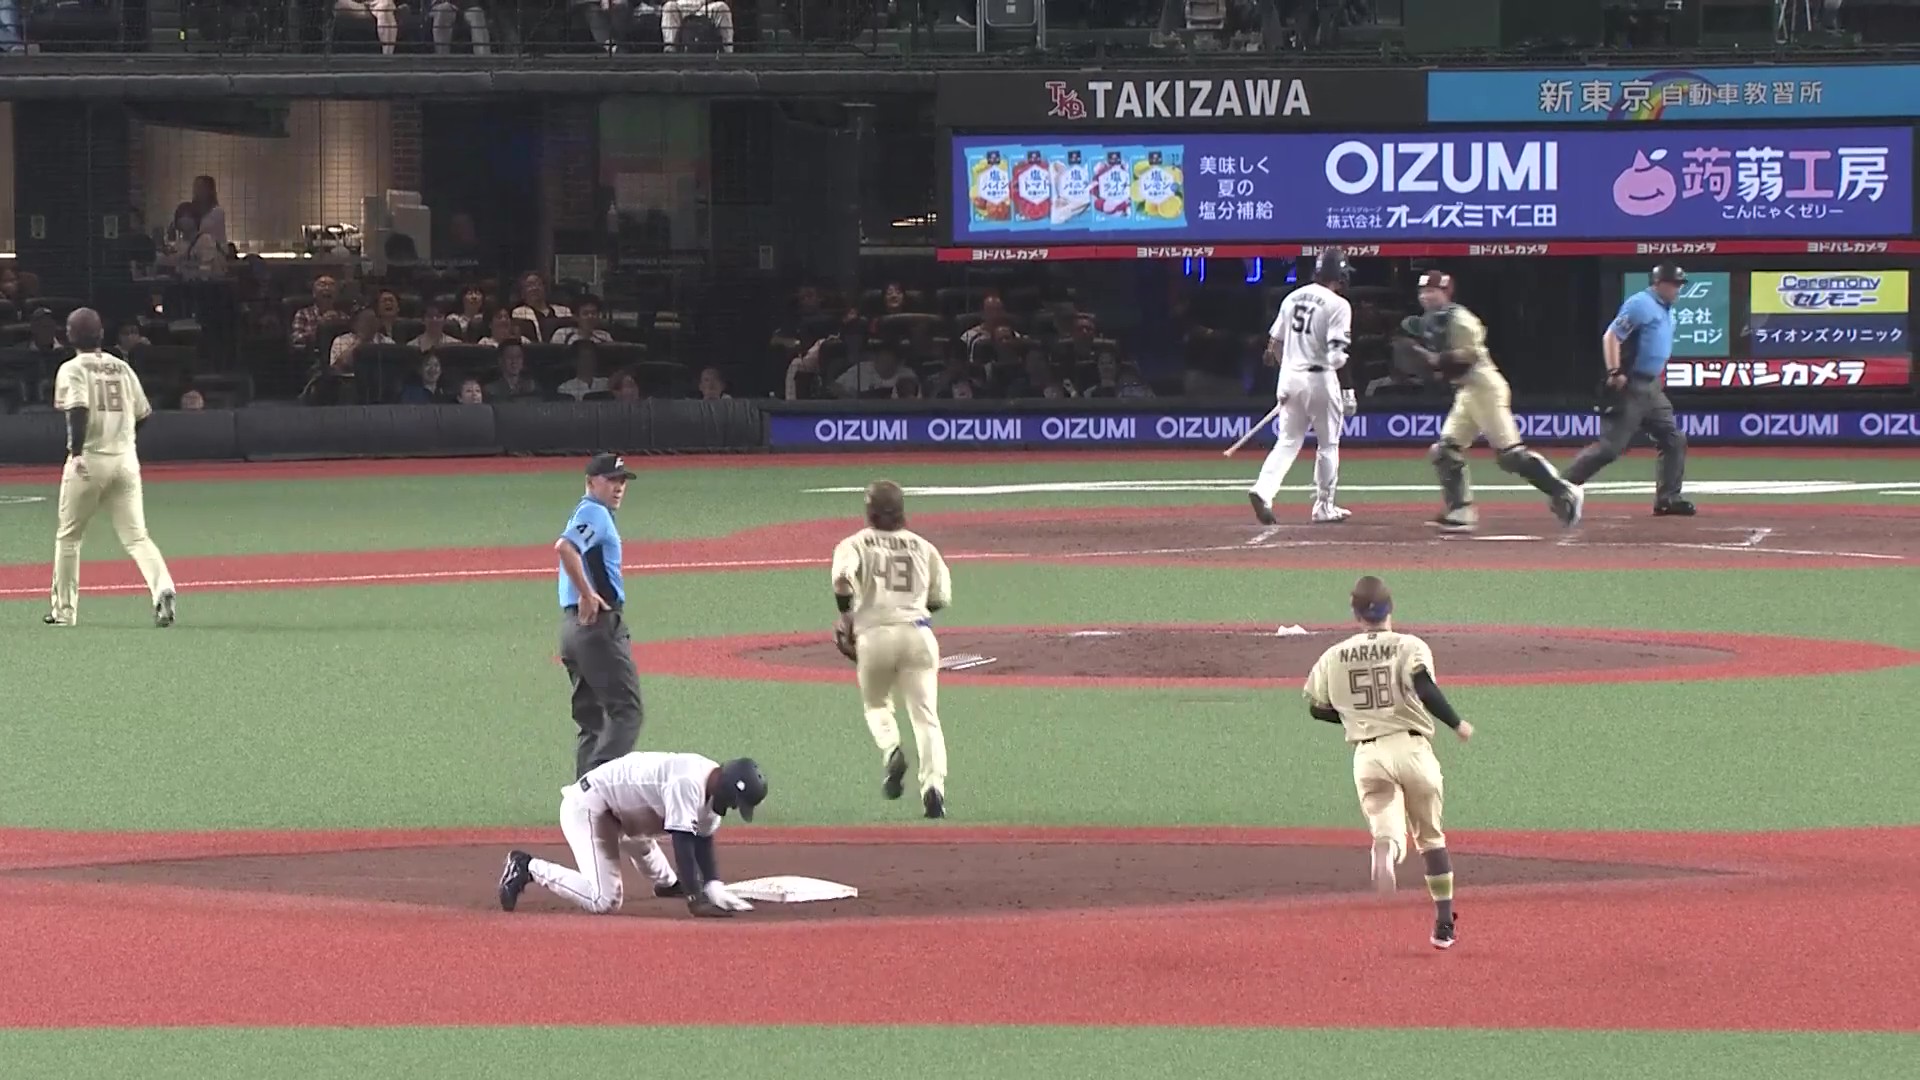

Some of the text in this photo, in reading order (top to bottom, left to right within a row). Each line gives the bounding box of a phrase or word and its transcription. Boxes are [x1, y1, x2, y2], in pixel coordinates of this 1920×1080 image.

[1088, 80, 1311, 118] TAKIZAWA
[1540, 79, 1822, 113] 新東京自動車教習所
[1200, 156, 1270, 175] 美味しく
[1325, 141, 1557, 194] OIZUMI
[1682, 147, 1888, 202] 蒟蒻工房
[1218, 179, 1254, 198] 夏の
[1199, 201, 1274, 220] 塩分補給
[1326, 202, 1557, 229] 株式会社 オーイズミ下仁田
[1722, 205, 1844, 219] こんにゃくゼリー
[972, 249, 1048, 260] ヨドバシカメラ
[1137, 246, 1215, 257] ヨドバシカメラ
[1302, 245, 1380, 257] ヨドカメラ
[1469, 244, 1548, 255] ヨドバシカメラ
[1636, 243, 1716, 254] ヨドバシカメラ
[1807, 242, 1887, 252] ヨドバシカメラ
[1782, 275, 1880, 290] Ceremony
[1793, 292, 1877, 307] セレモニー
[1292, 304, 1315, 335] 51
[1673, 328, 1723, 344] ーロジ
[1756, 328, 1902, 343] ライオンズクリニック
[1666, 361, 1865, 387] ヨドバシカメラ
[96, 379, 123, 412] 18
[815, 419, 908, 441] OIZUMI
[928, 418, 1021, 440] OIZUMI
[1041, 417, 1135, 439] OIZUMI
[1155, 416, 1250, 439] OIZUMI
[1740, 413, 1838, 436] OIZUMI
[576, 524, 595, 547] 41
[871, 555, 914, 592] 43
[1348, 666, 1394, 710] 58
